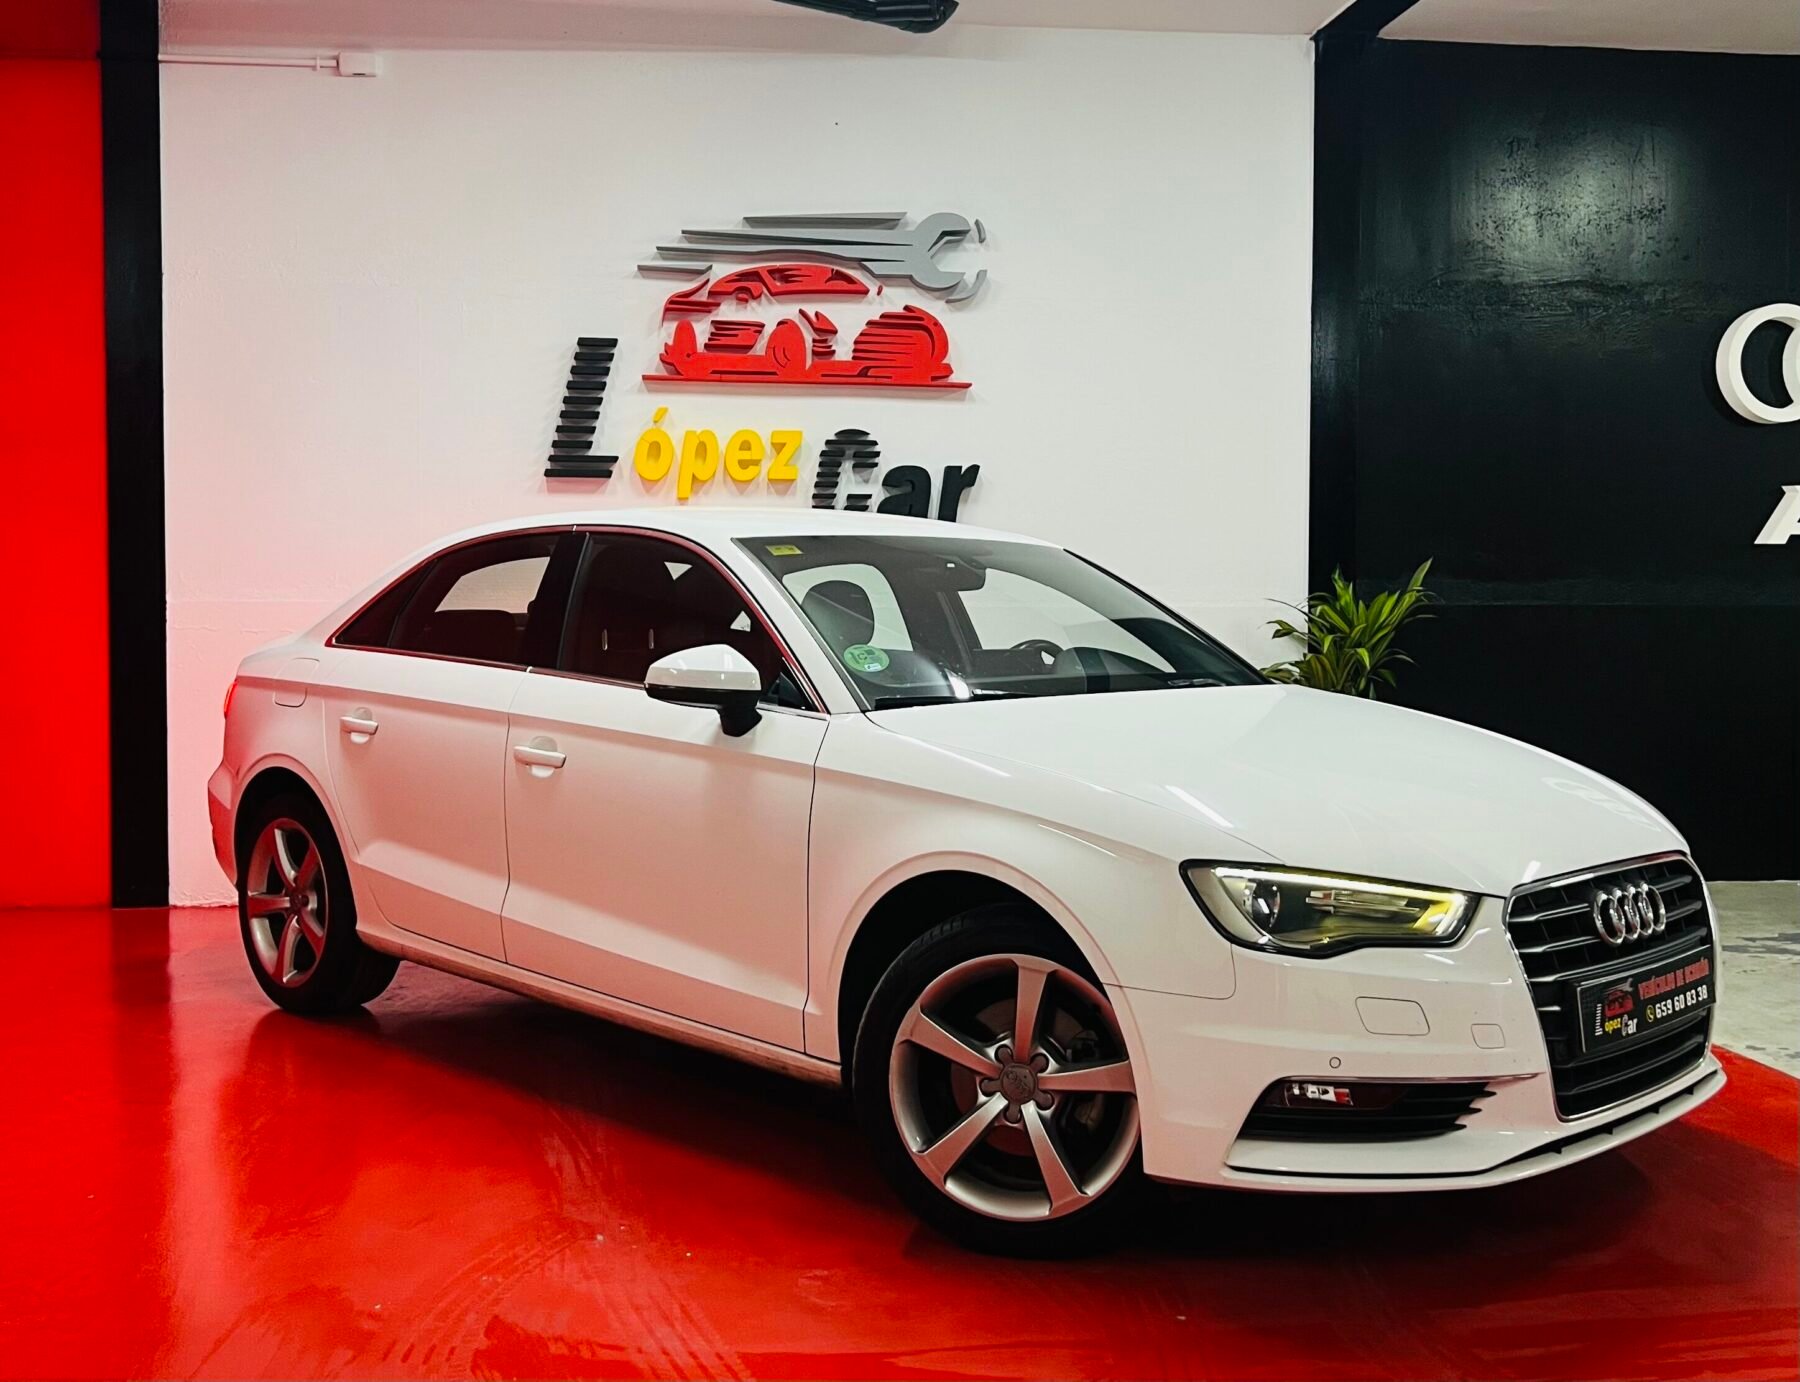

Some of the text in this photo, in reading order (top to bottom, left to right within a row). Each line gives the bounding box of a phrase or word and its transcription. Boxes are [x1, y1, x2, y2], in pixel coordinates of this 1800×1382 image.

[544, 337, 980, 523] López Car
[1655, 984, 1708, 1019] 659 60 83 38
[1621, 1014, 1638, 1037] Car
